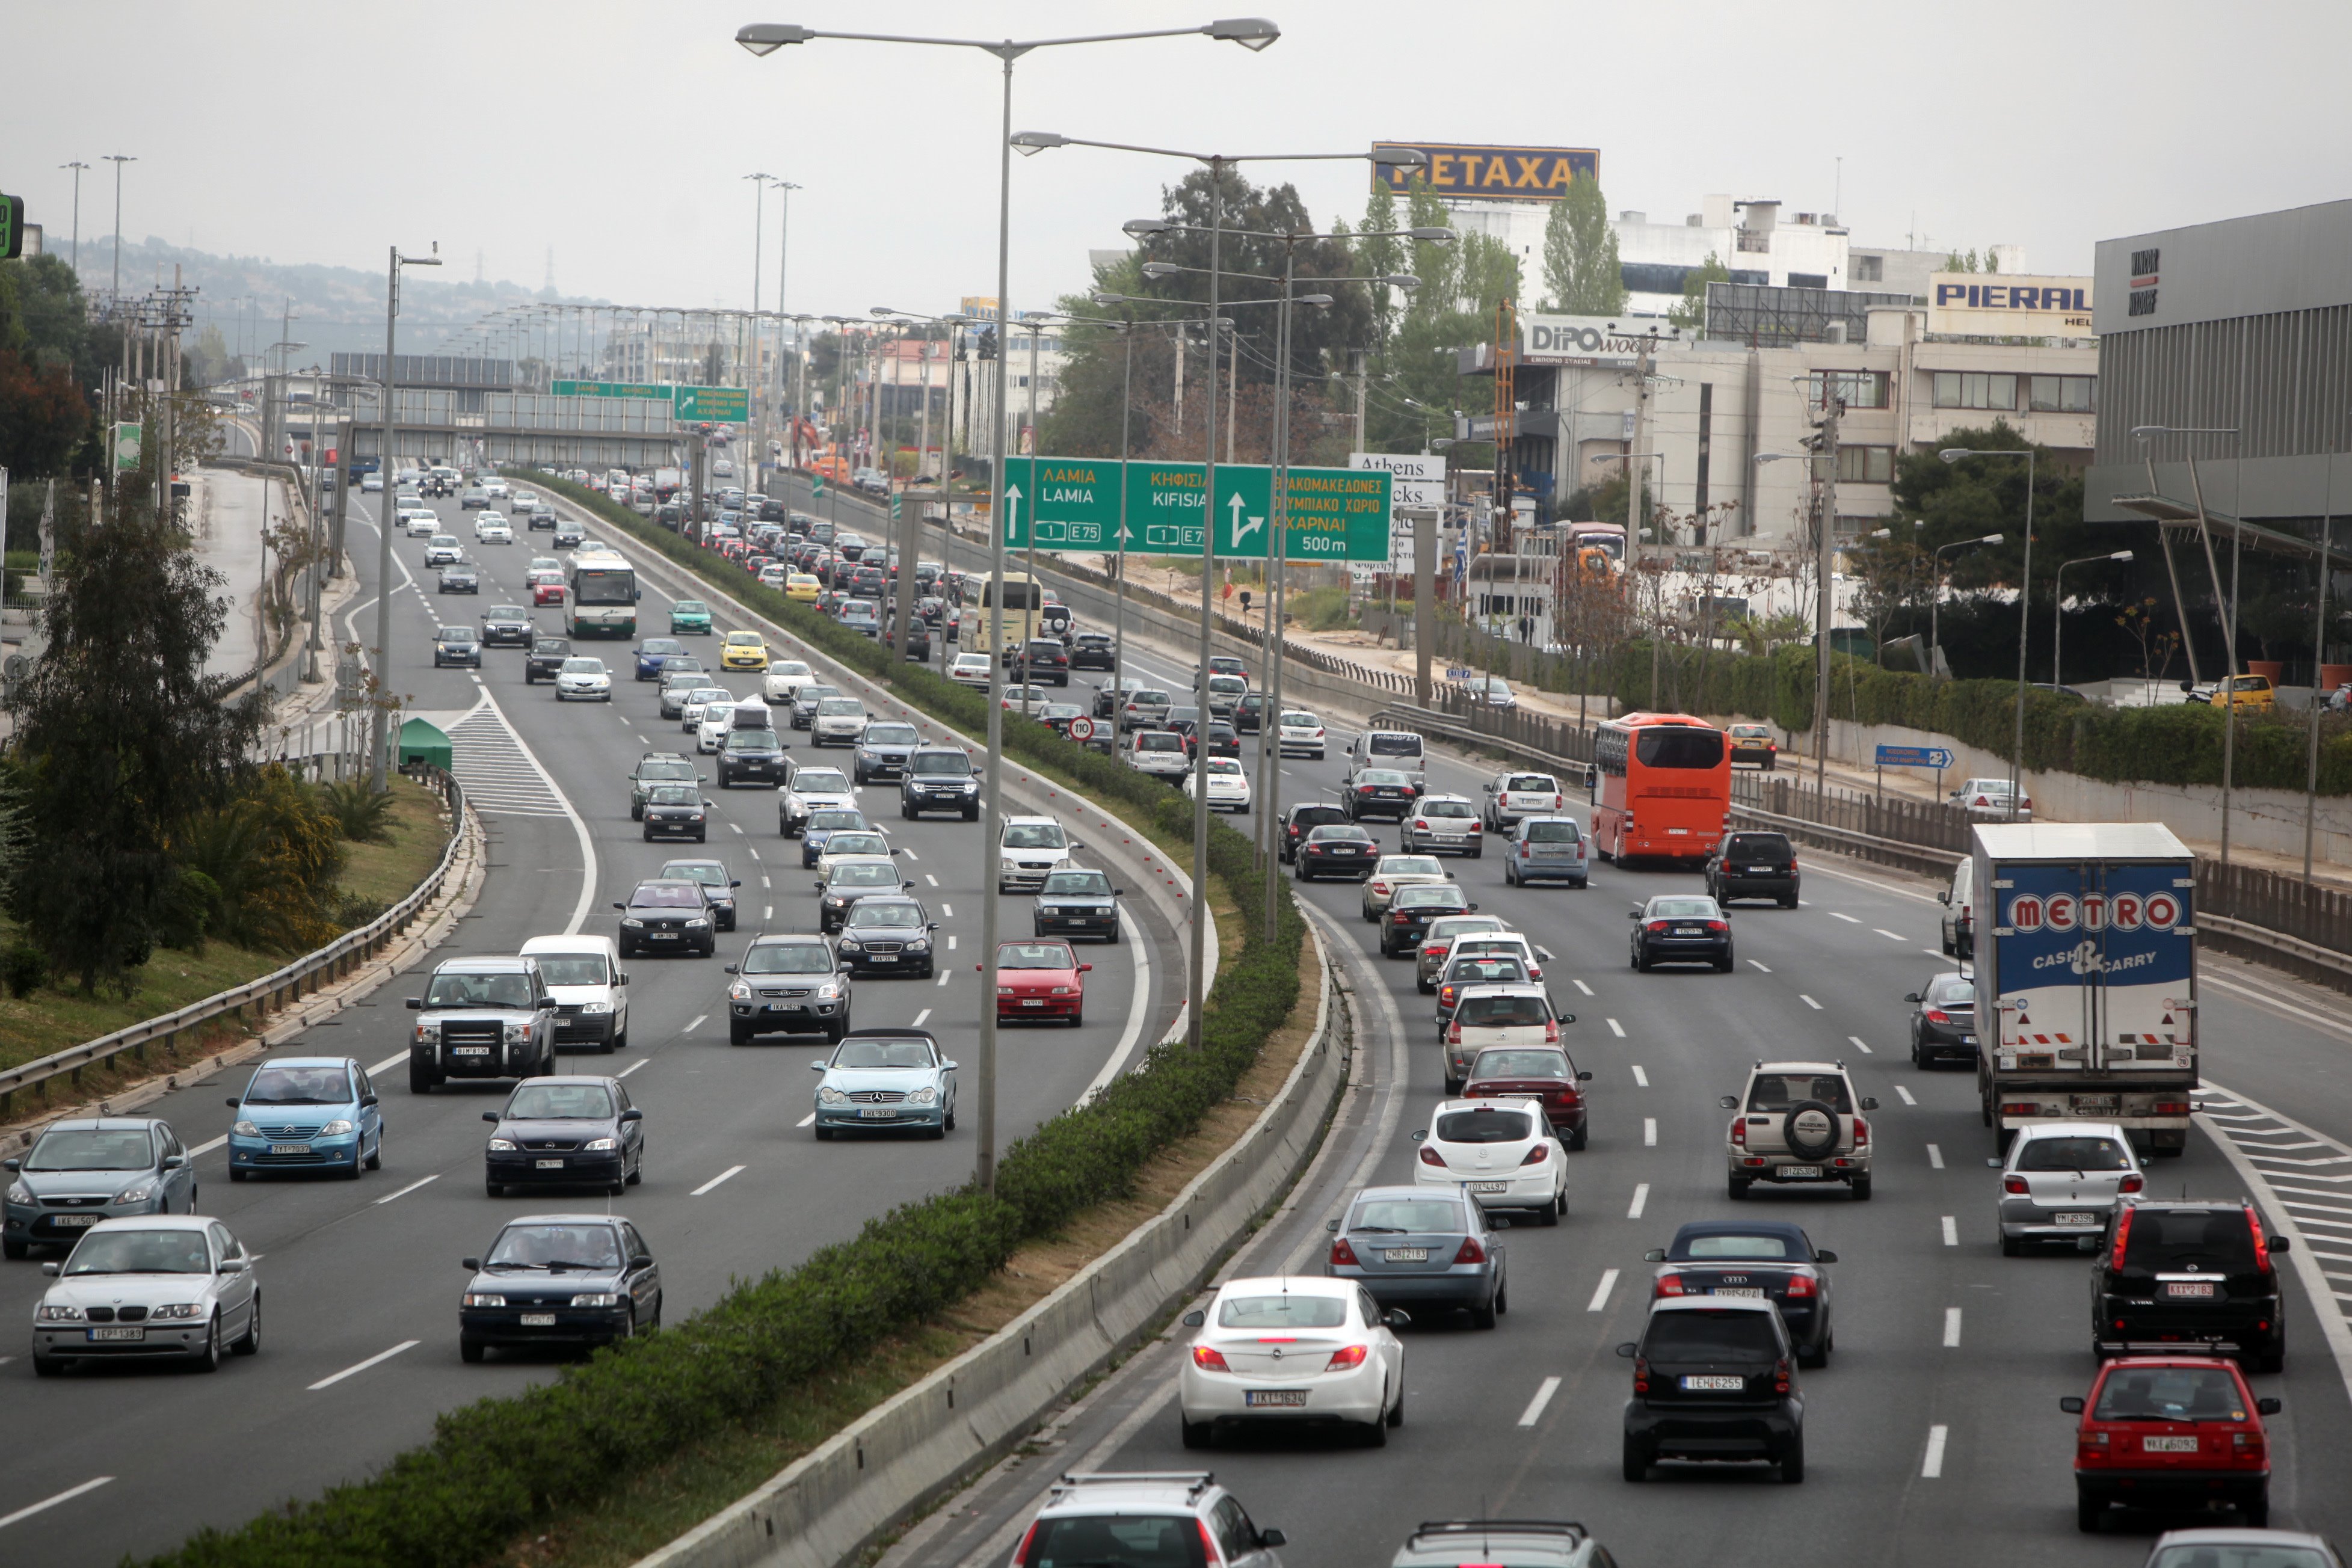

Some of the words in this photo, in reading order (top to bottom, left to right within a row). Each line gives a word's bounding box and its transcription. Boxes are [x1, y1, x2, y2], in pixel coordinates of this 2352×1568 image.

[1042, 468, 1095, 484] ΛΑΜΙΑ
[1043, 488, 1094, 503] LAMIA
[1274, 496, 1339, 512] ΟΥΜΠΙΑΚΟ
[1346, 499, 1381, 514] ΧΩΡΙΟ
[1048, 525, 1053, 537] 1
[1072, 527, 1080, 538] E
[1083, 527, 1097, 539] 75
[1195, 531, 1205, 543] 7
[1302, 536, 1330, 551] 500
[1332, 541, 1346, 552] m
[1075, 724, 1089, 733] 110
[2016, 899, 2175, 926] METRO
